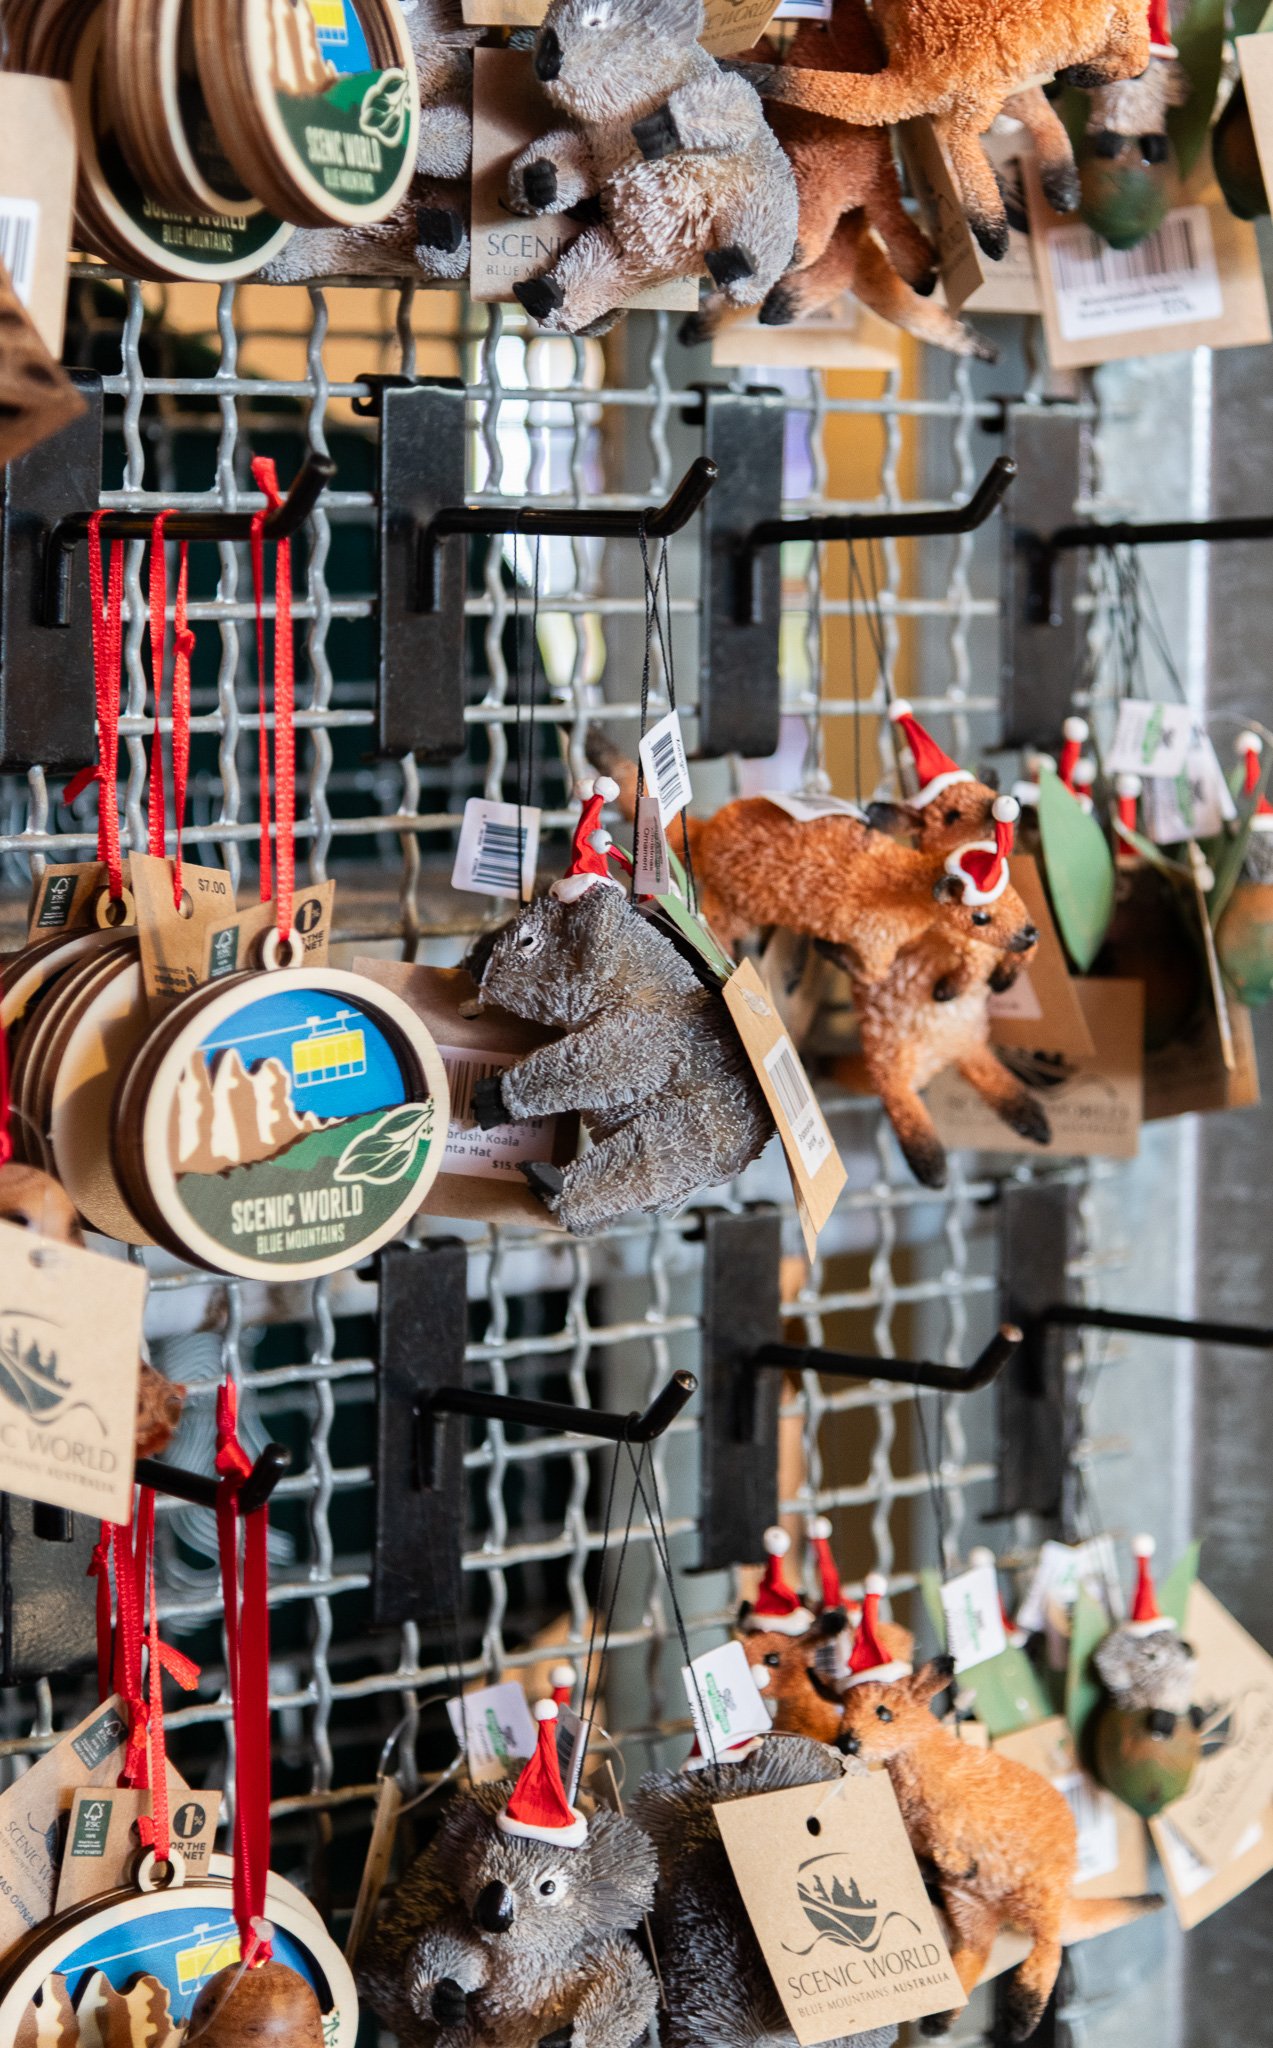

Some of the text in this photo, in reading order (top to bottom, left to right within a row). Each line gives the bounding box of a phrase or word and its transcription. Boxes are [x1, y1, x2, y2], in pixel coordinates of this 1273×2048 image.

[305, 125, 382, 173] SCENIC WORLD
[162, 223, 184, 246] BLUE
[184, 227, 233, 253] MOUNTAINS
[486, 263, 520, 277] BLUE
[642, 827, 650, 871] Ornament
[198, 878, 227, 895] $7.00
[307, 929, 324, 942] THE
[445, 1143, 492, 1157] nta Hat
[486, 1134, 520, 1147] Koala
[231, 1184, 364, 1235] SCENIC WORLD
[256, 1223, 346, 1255] BLUE MOUNTAINS
[26, 1427, 117, 1474] WORLD
[183, 1805, 204, 1836] 1%
[5, 1821, 41, 1868] SCENIC
[188, 1842, 206, 1851] THE
[788, 1942, 941, 2000] SCENIC WORLD
[797, 1971, 951, 2019] BLUE MOUNTAINS AUSTRALIA
